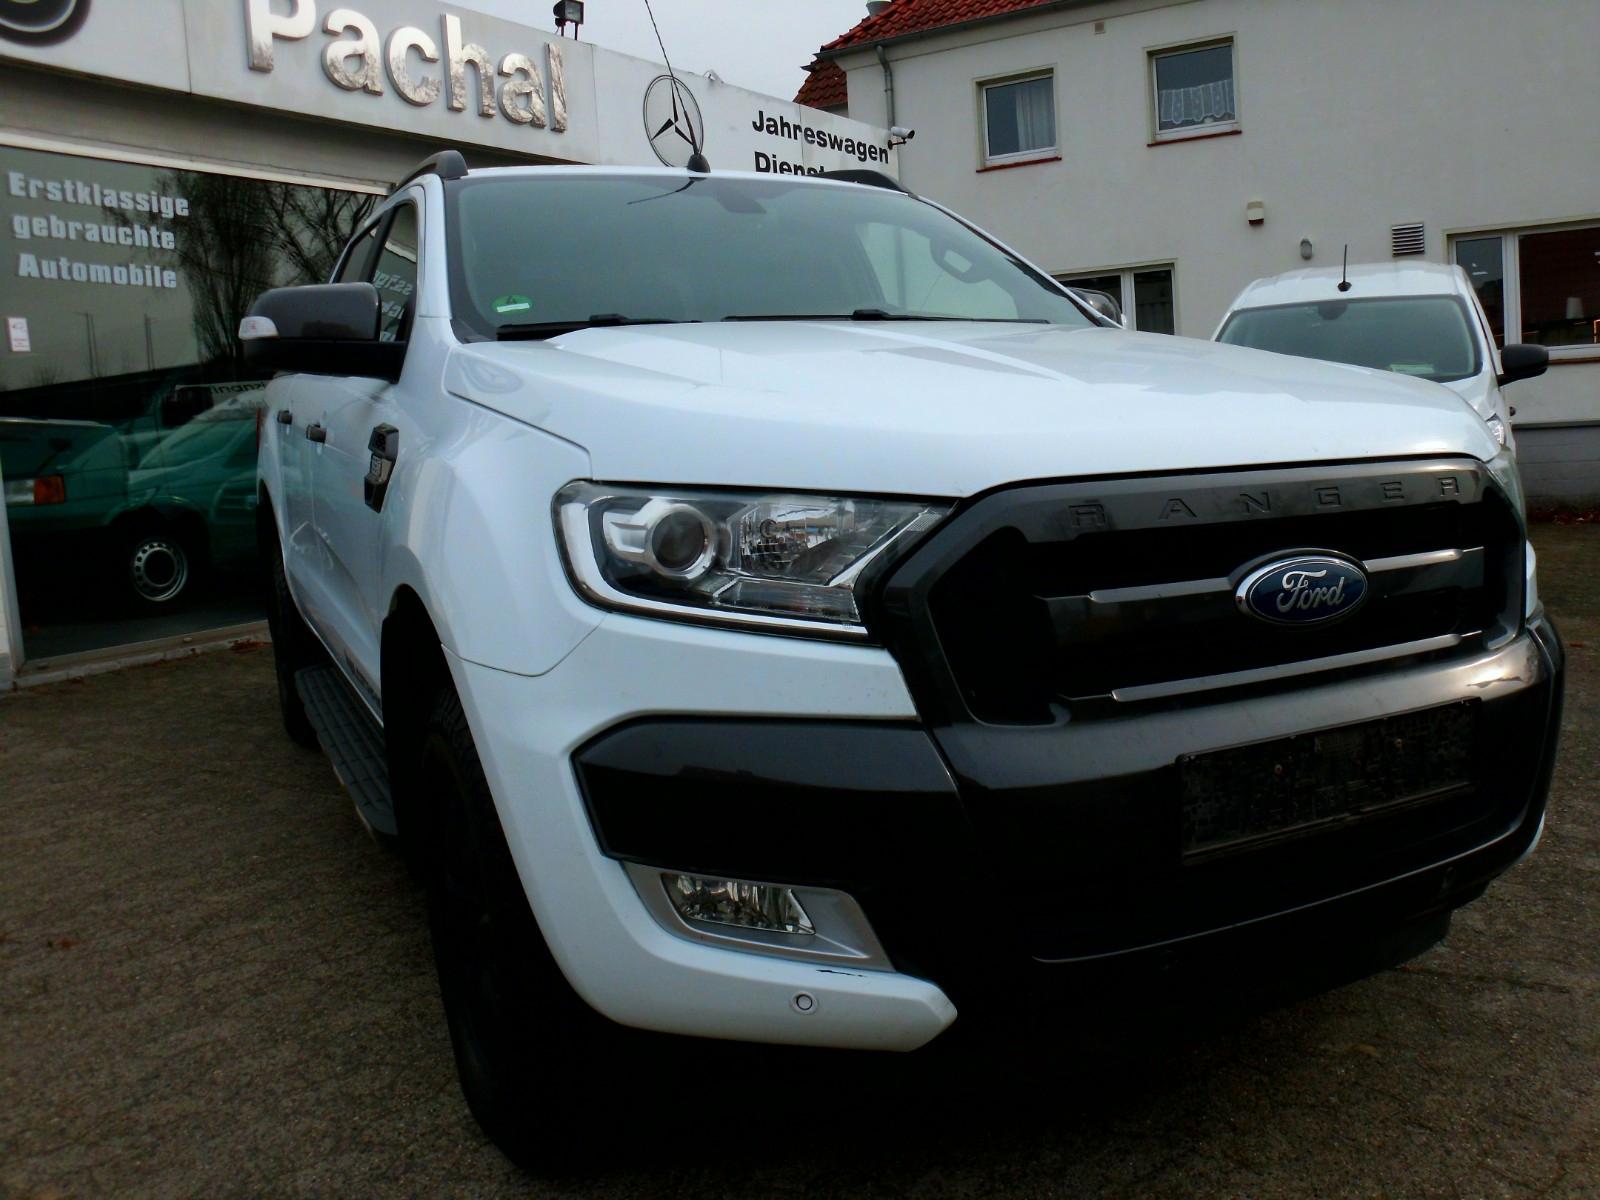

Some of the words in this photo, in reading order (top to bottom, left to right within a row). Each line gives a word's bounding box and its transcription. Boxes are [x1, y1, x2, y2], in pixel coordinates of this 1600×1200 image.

[243, 0, 568, 133] Pachal
[752, 110, 889, 164] Jahreswagen
[8, 170, 190, 219] Erstklassige
[12, 214, 175, 249] gebrauchte
[18, 252, 177, 288] Automobile
[1069, 476, 1462, 527] RANGER
[1276, 569, 1345, 613] Ford
